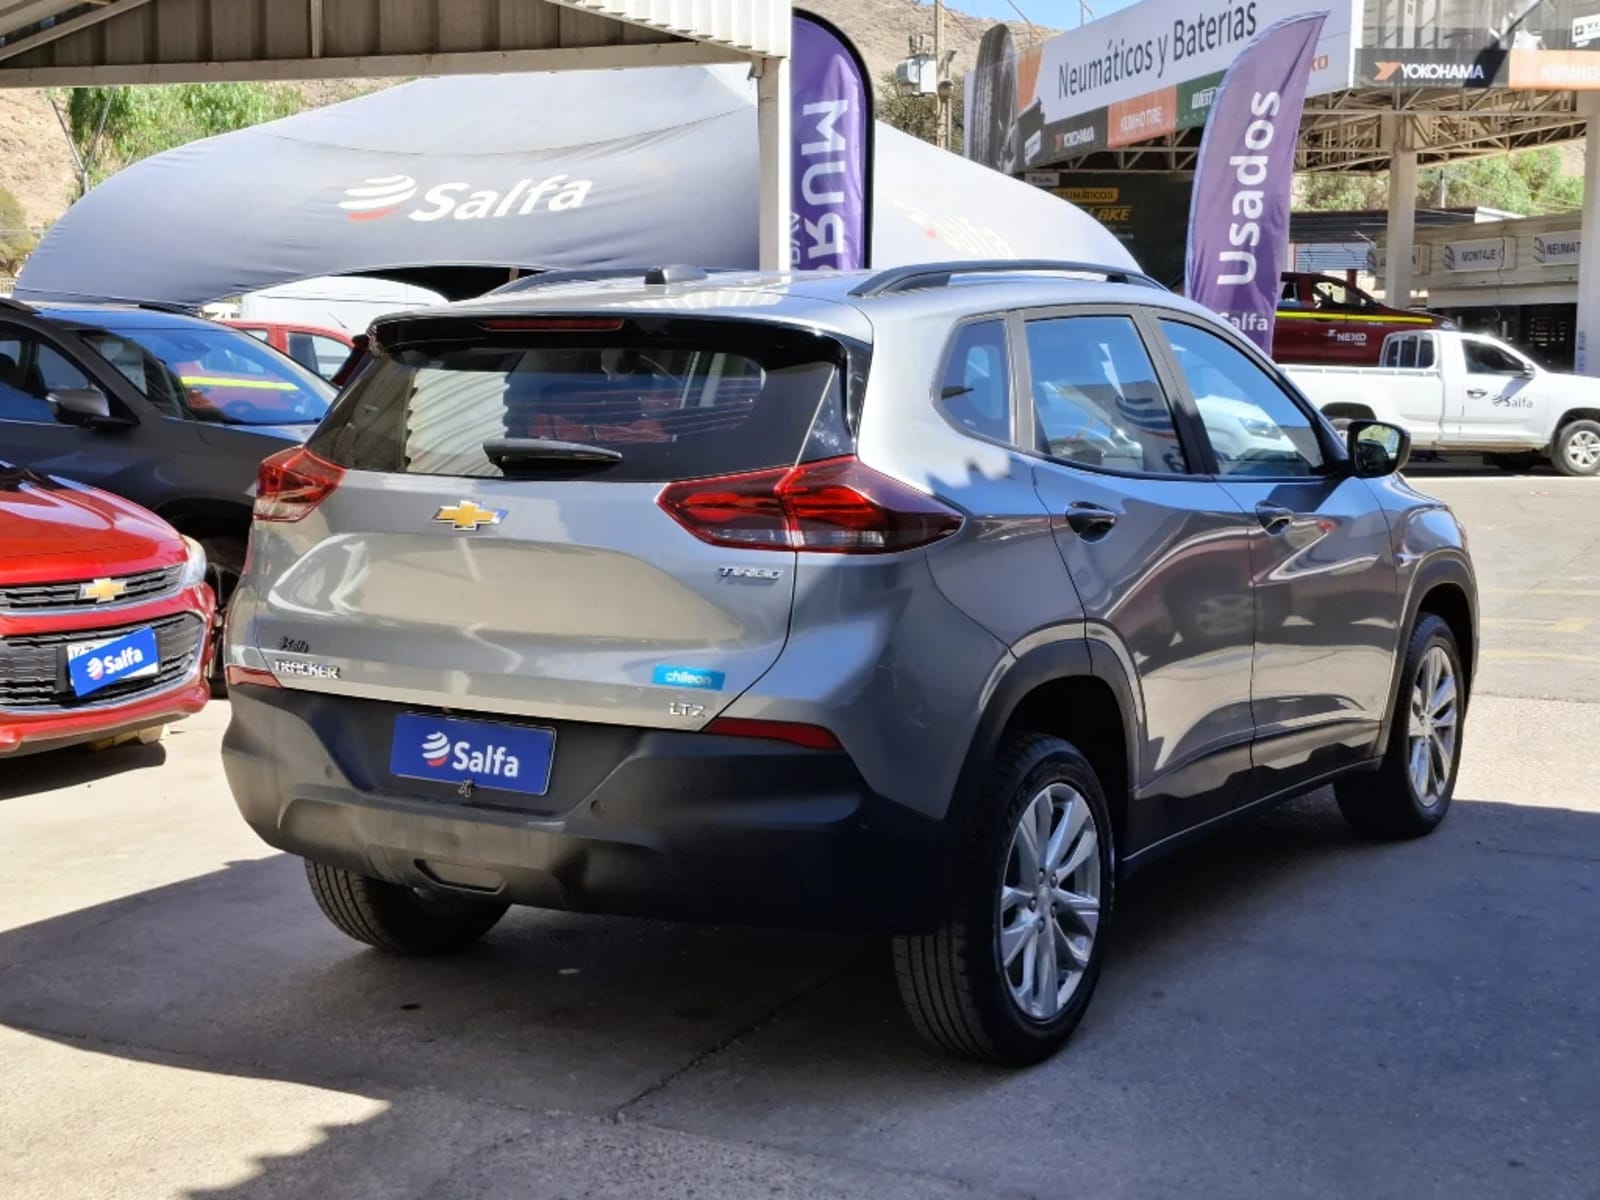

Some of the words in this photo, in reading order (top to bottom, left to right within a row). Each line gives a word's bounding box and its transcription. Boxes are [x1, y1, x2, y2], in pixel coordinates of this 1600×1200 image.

[1058, 39, 1153, 100] Neumáticos
[1157, 33, 1169, 79] y
[1401, 63, 1485, 79] YOKOHAMA
[408, 174, 593, 222] Salfa
[1216, 91, 1281, 285] Usados
[1461, 249, 1497, 262] MONTAJE
[1504, 396, 1534, 408] Salfa
[103, 646, 144, 675] Salfa
[275, 660, 341, 679] TRACKER
[669, 702, 705, 718] LTZ
[452, 740, 520, 778] Salfa
